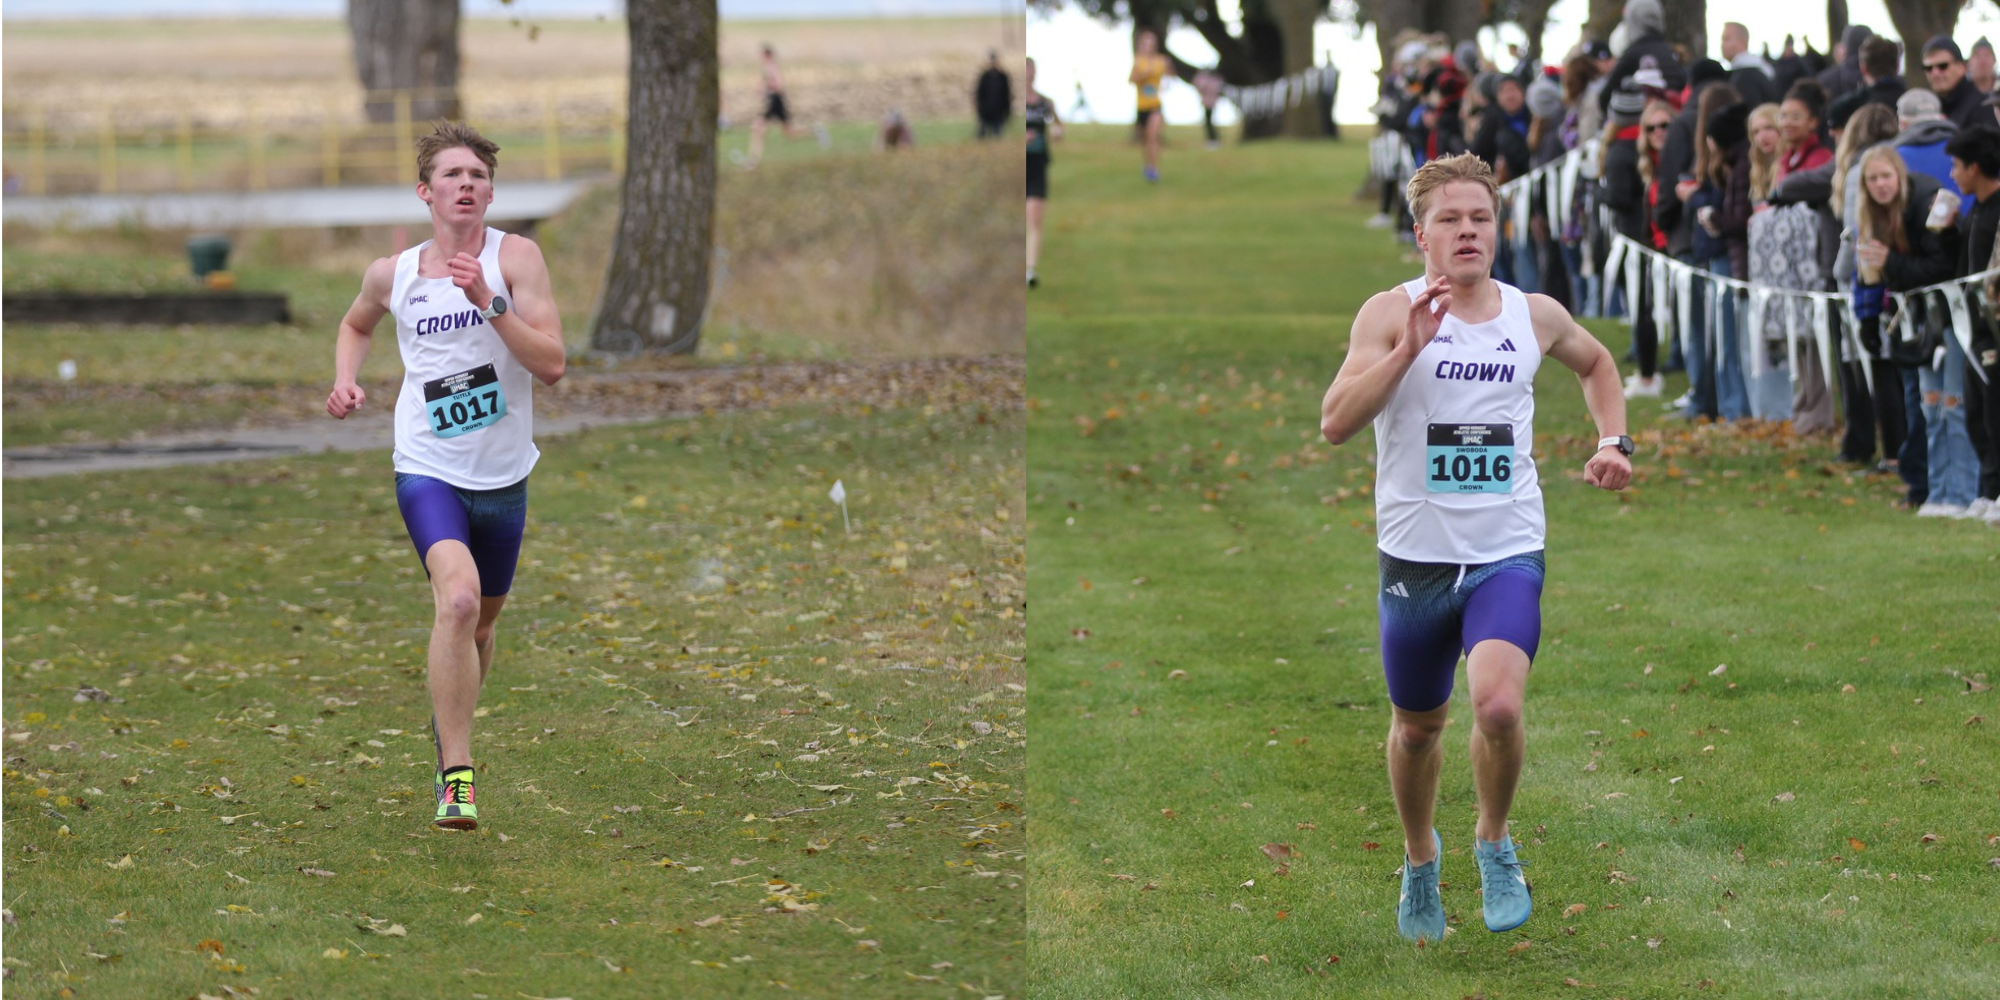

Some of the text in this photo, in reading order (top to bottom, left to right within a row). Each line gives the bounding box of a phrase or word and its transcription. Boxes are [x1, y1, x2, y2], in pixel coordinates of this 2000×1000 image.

[416, 309, 483, 336] CROWN
[1435, 360, 1516, 383] CROWN
[453, 391, 471, 400] TUTTLE
[432, 390, 498, 431] 1017
[462, 421, 483, 431] CROWN
[1462, 435, 1483, 445] UMAC
[1431, 454, 1511, 482] 1016
